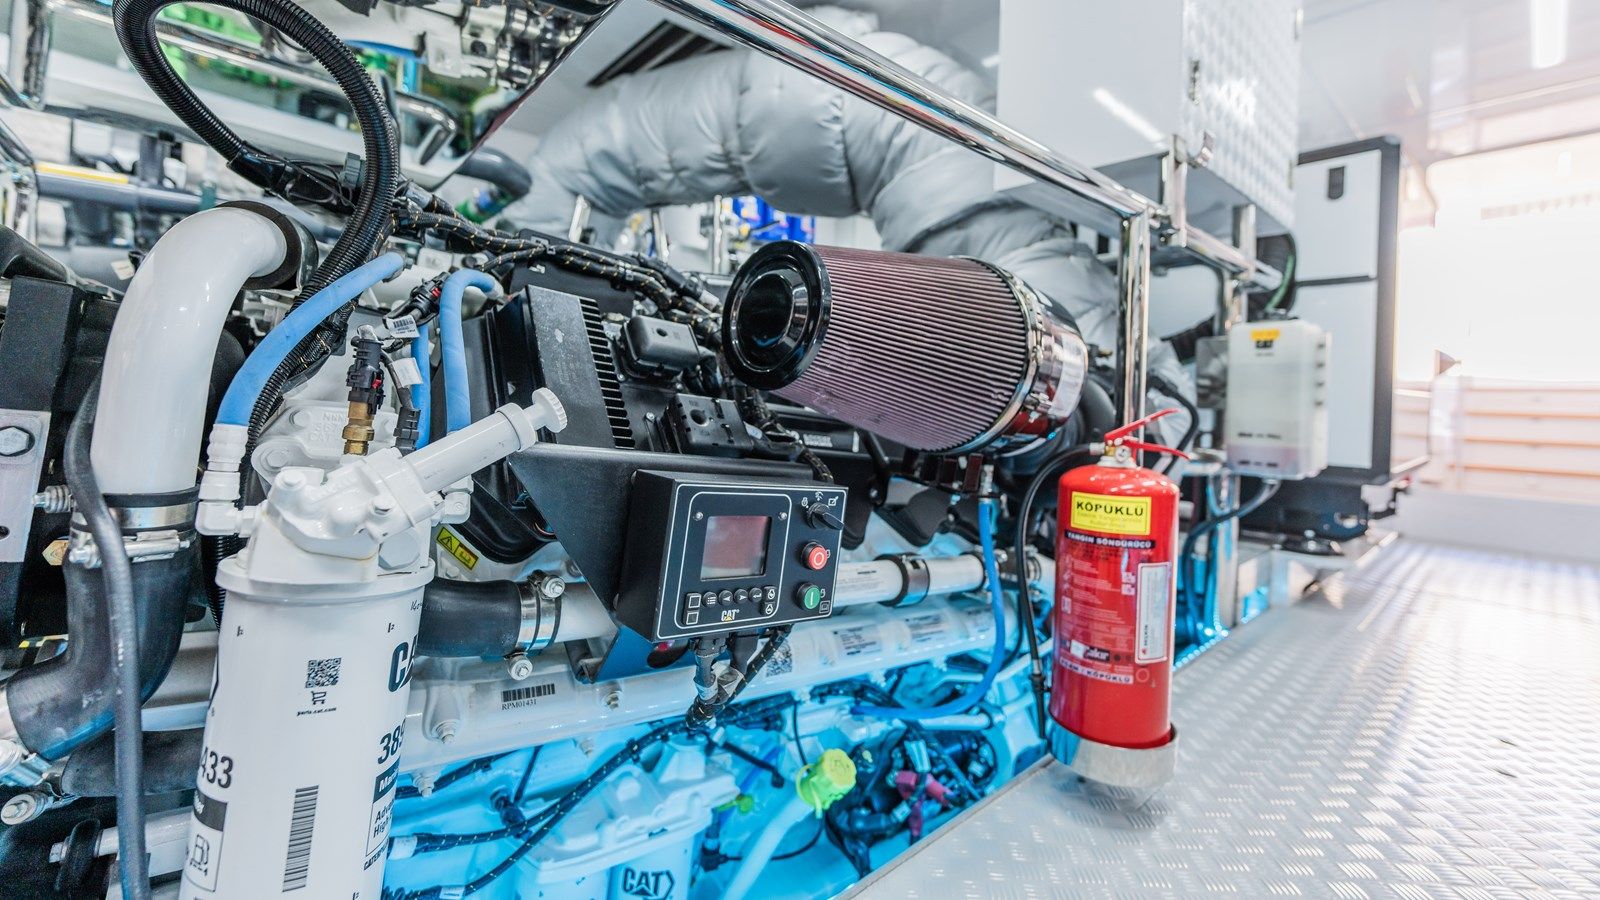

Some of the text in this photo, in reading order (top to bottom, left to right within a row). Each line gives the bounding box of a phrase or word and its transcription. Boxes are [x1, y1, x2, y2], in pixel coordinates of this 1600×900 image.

[1076, 501, 1144, 516] KÖPÜKLÜ
[501, 699, 537, 711] RPM01431
[623, 867, 662, 897] CAT
